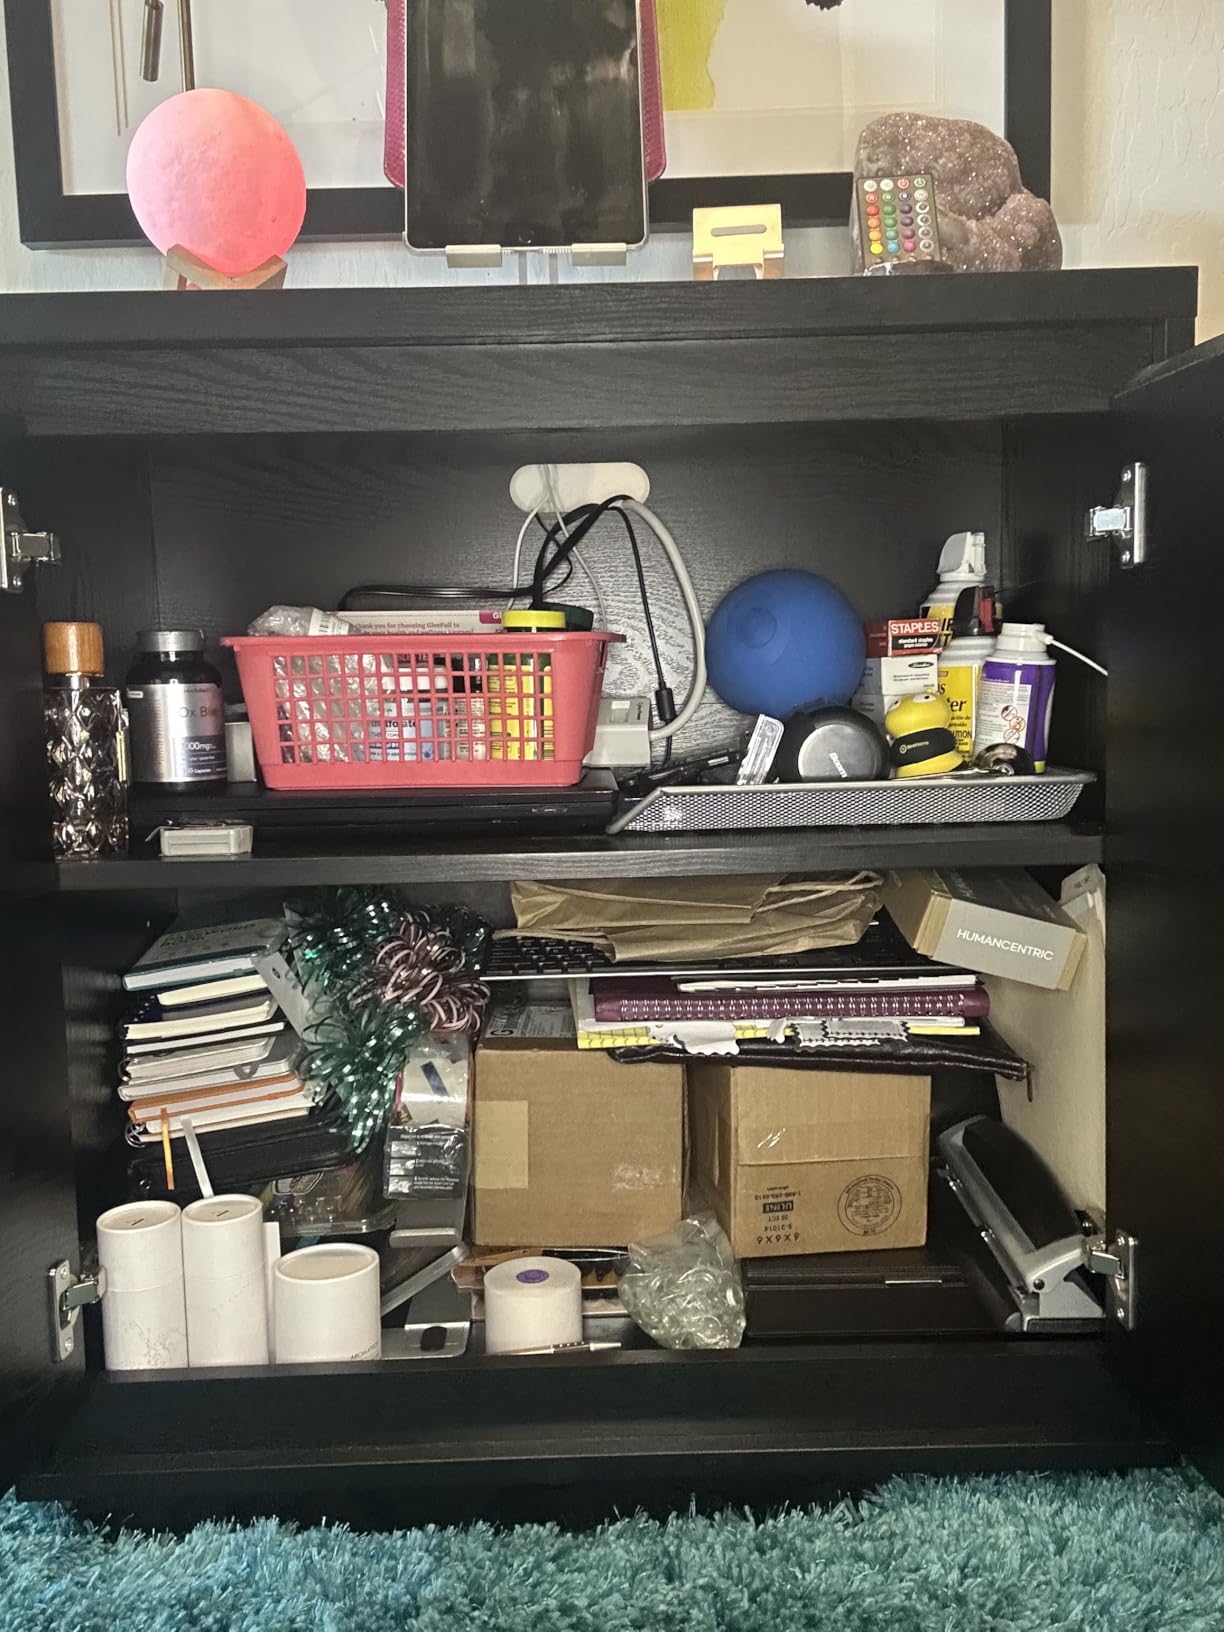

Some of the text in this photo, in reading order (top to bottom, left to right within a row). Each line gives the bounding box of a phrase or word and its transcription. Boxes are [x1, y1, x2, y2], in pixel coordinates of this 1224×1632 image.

[891, 621, 940, 635] STAPLES
[956, 928, 1055, 961] HUMANCENTRIC
[764, 1201, 793, 1213] ULINE
